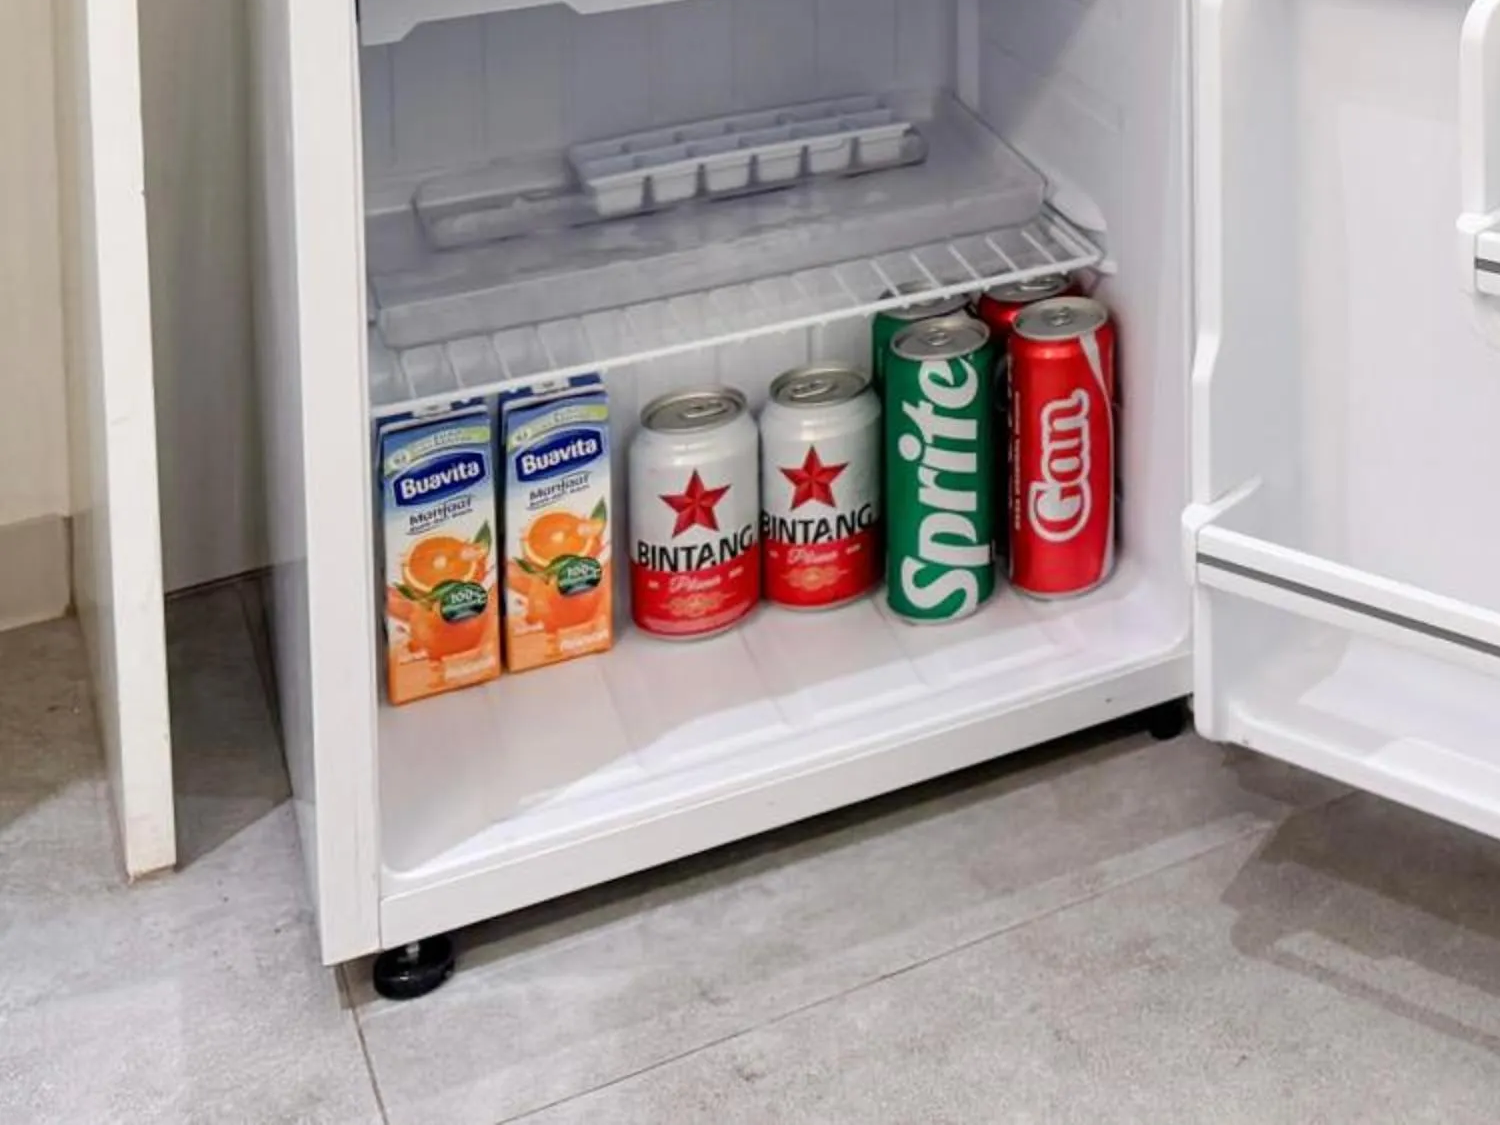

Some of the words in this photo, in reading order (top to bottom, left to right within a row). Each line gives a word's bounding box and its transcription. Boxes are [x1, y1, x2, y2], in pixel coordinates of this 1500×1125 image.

[521, 438, 598, 475] Buavita
[400, 460, 480, 500] Buavita
[898, 357, 991, 621] Sprite
[761, 502, 872, 544] BINTANG
[637, 524, 754, 574] BINTANG
